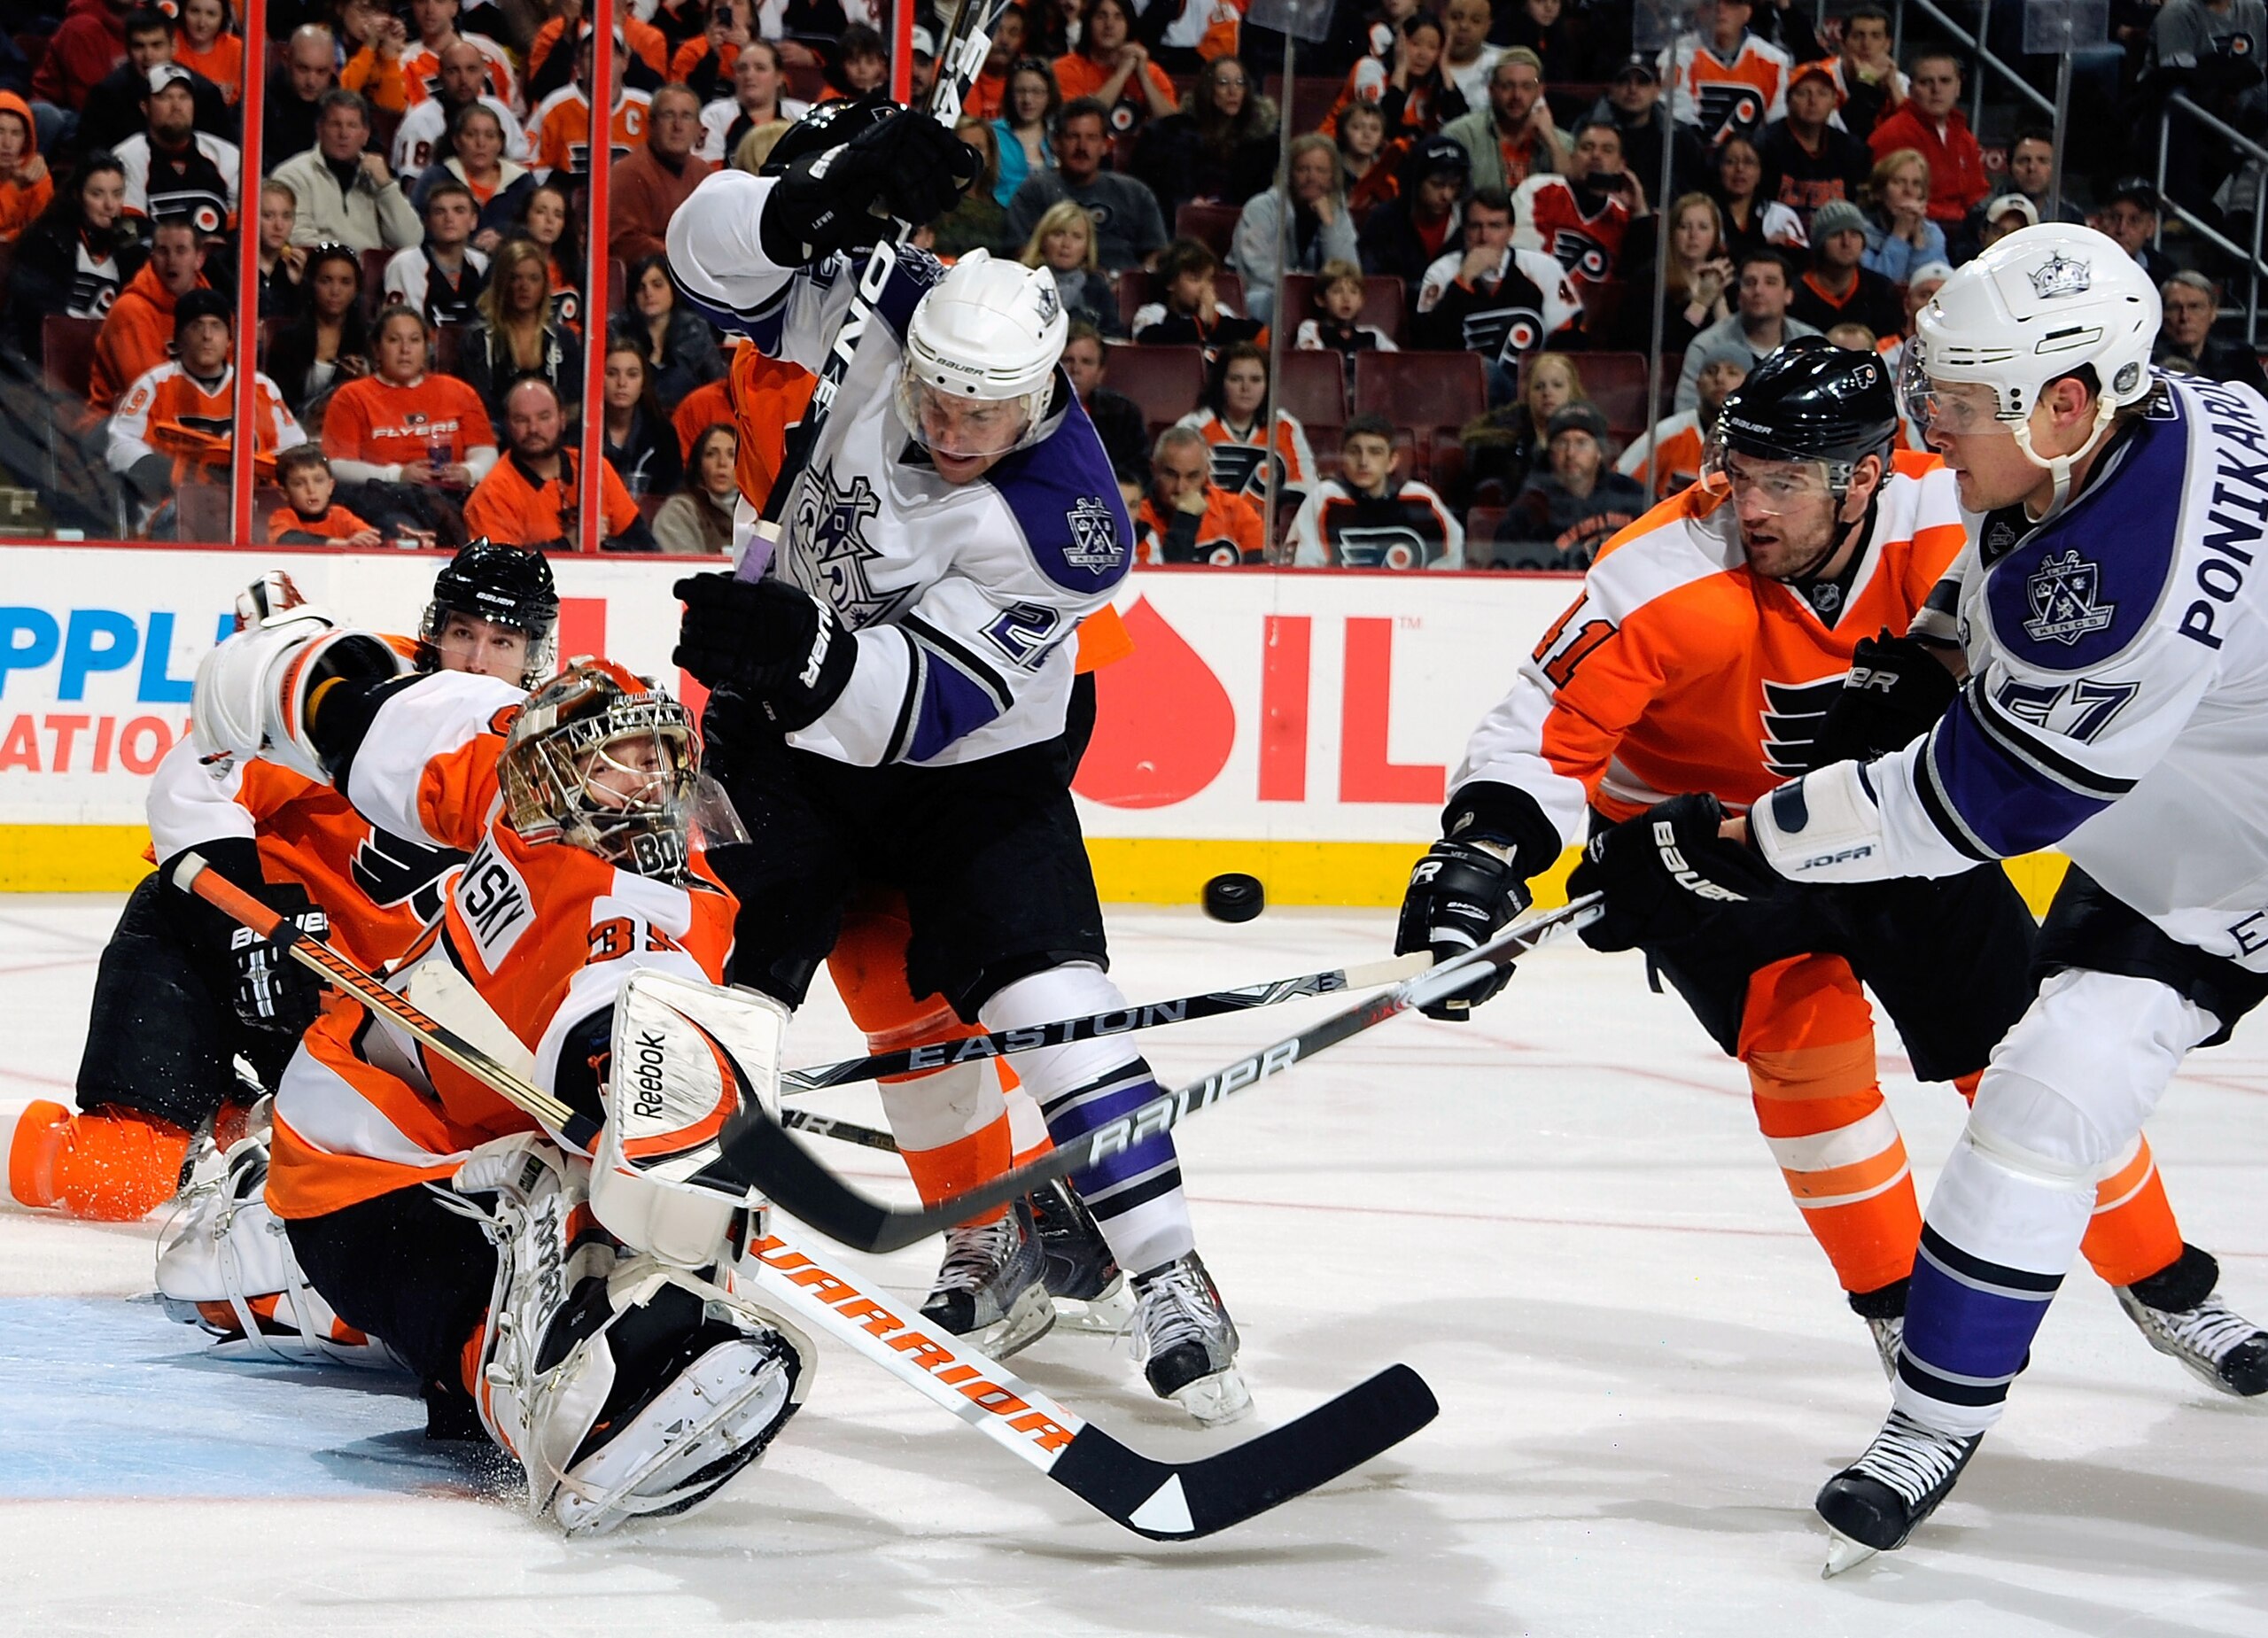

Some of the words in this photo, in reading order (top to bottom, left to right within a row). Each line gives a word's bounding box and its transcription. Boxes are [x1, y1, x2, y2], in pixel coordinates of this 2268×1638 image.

[936, 357, 984, 377] BAUER
[371, 419, 459, 440] FLYERS
[1730, 416, 1773, 435] BAUER
[475, 591, 517, 608] BAUER
[0, 606, 237, 703] PPL
[977, 601, 1083, 673] 2
[0, 713, 192, 776] ATIO
[1795, 845, 1873, 872] JOFA
[908, 998, 1187, 1072] EASTON
[633, 1030, 665, 1120] Reebok
